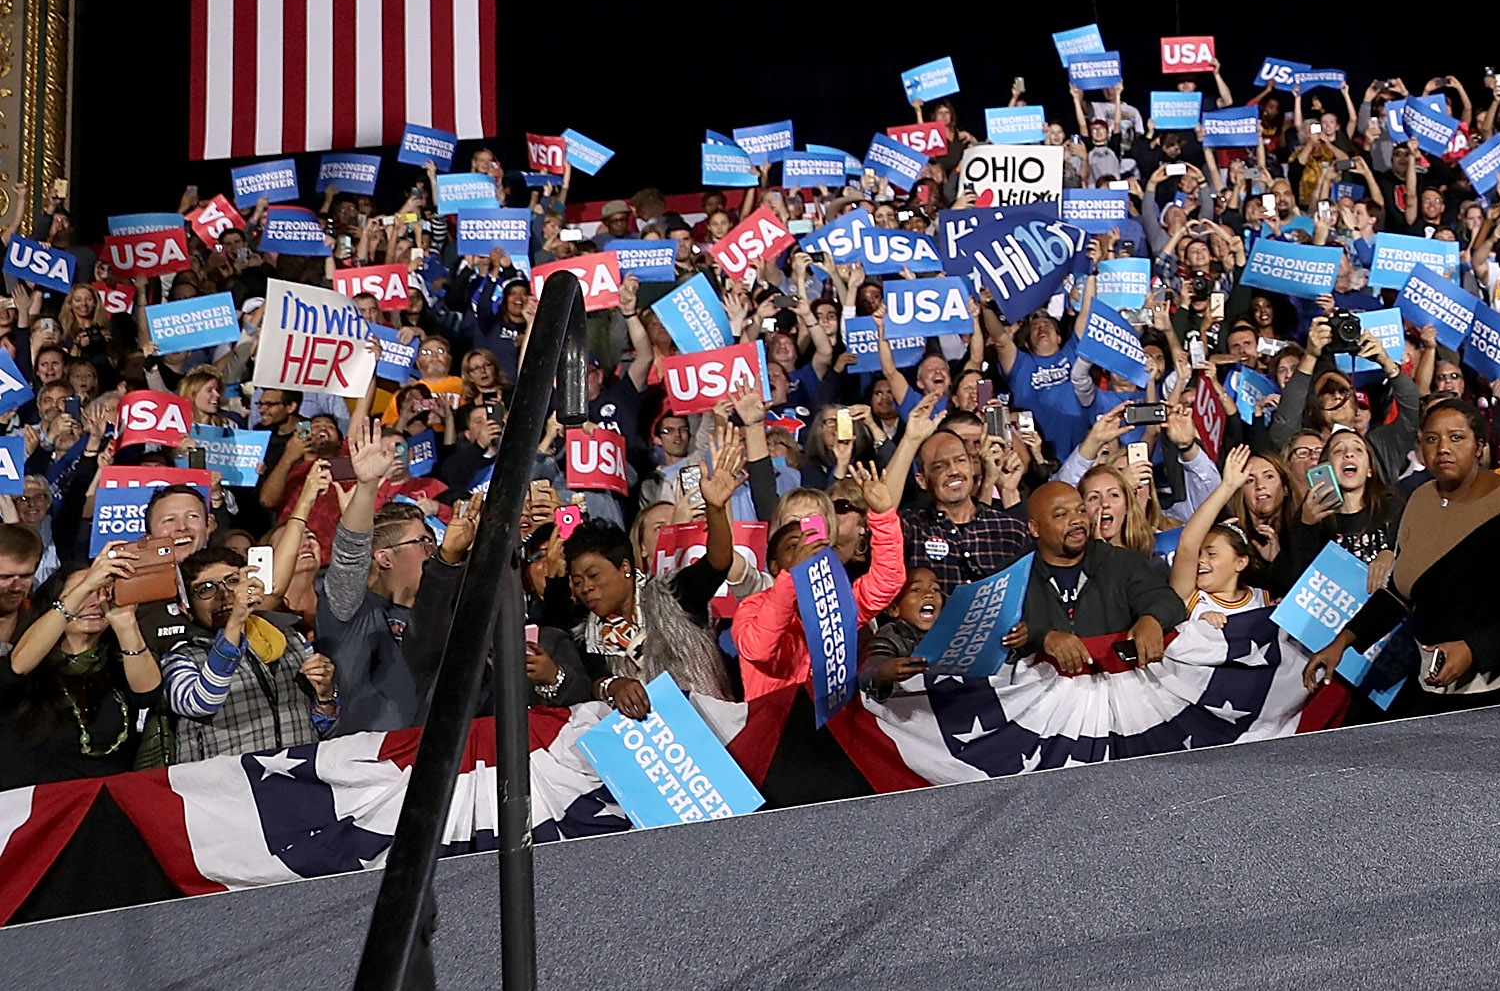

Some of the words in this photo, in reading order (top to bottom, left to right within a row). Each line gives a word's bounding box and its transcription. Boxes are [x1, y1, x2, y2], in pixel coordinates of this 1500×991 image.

[1070, 60, 1119, 71] STRONGER
[1163, 43, 1213, 65] USA
[1071, 68, 1120, 78] TOGETHER
[1261, 63, 1295, 84] US
[1204, 117, 1256, 127] STRONGER
[1205, 124, 1256, 134] TOGETHER
[405, 133, 455, 153] STRONGER
[737, 130, 791, 146] STRONGER
[404, 142, 453, 160] TOGETHER
[528, 140, 563, 167] USA
[871, 142, 922, 173] STRONGER
[319, 169, 375, 183] TOGETHER
[320, 162, 376, 174] STRONGER
[786, 159, 843, 170] STRONGER
[786, 167, 843, 177] TOGETHER
[869, 151, 918, 179] TOGETHER
[965, 156, 1045, 184] OHIO
[235, 169, 294, 188] STRONGER
[237, 178, 296, 196] TOGETHER
[1063, 200, 1125, 209] STRONGER
[1063, 209, 1125, 219] TOGETHER
[460, 219, 527, 230] STRONGER
[460, 229, 527, 241] TOGETHER
[110, 238, 187, 270] USA
[720, 218, 786, 273] USA
[863, 235, 939, 263] USA
[1378, 247, 1444, 264] STRONGER
[9, 241, 71, 284] USA
[1254, 252, 1336, 275] STRONGER
[1251, 263, 1333, 286] TOGETHER
[887, 288, 970, 325] USA
[1408, 276, 1475, 324] STRONGER
[152, 305, 231, 328] STRONGER
[681, 285, 726, 349] STRONGE
[1403, 291, 1468, 335] TOGETHER
[154, 314, 235, 339] TOGETHER
[280, 334, 354, 389] HER
[667, 356, 757, 402] USA
[1197, 378, 1222, 454] USA
[571, 441, 626, 481] USA
[157, 626, 185, 637] BROWN
[809, 560, 841, 710] STRONGER
[817, 555, 848, 702] TOGETHER
